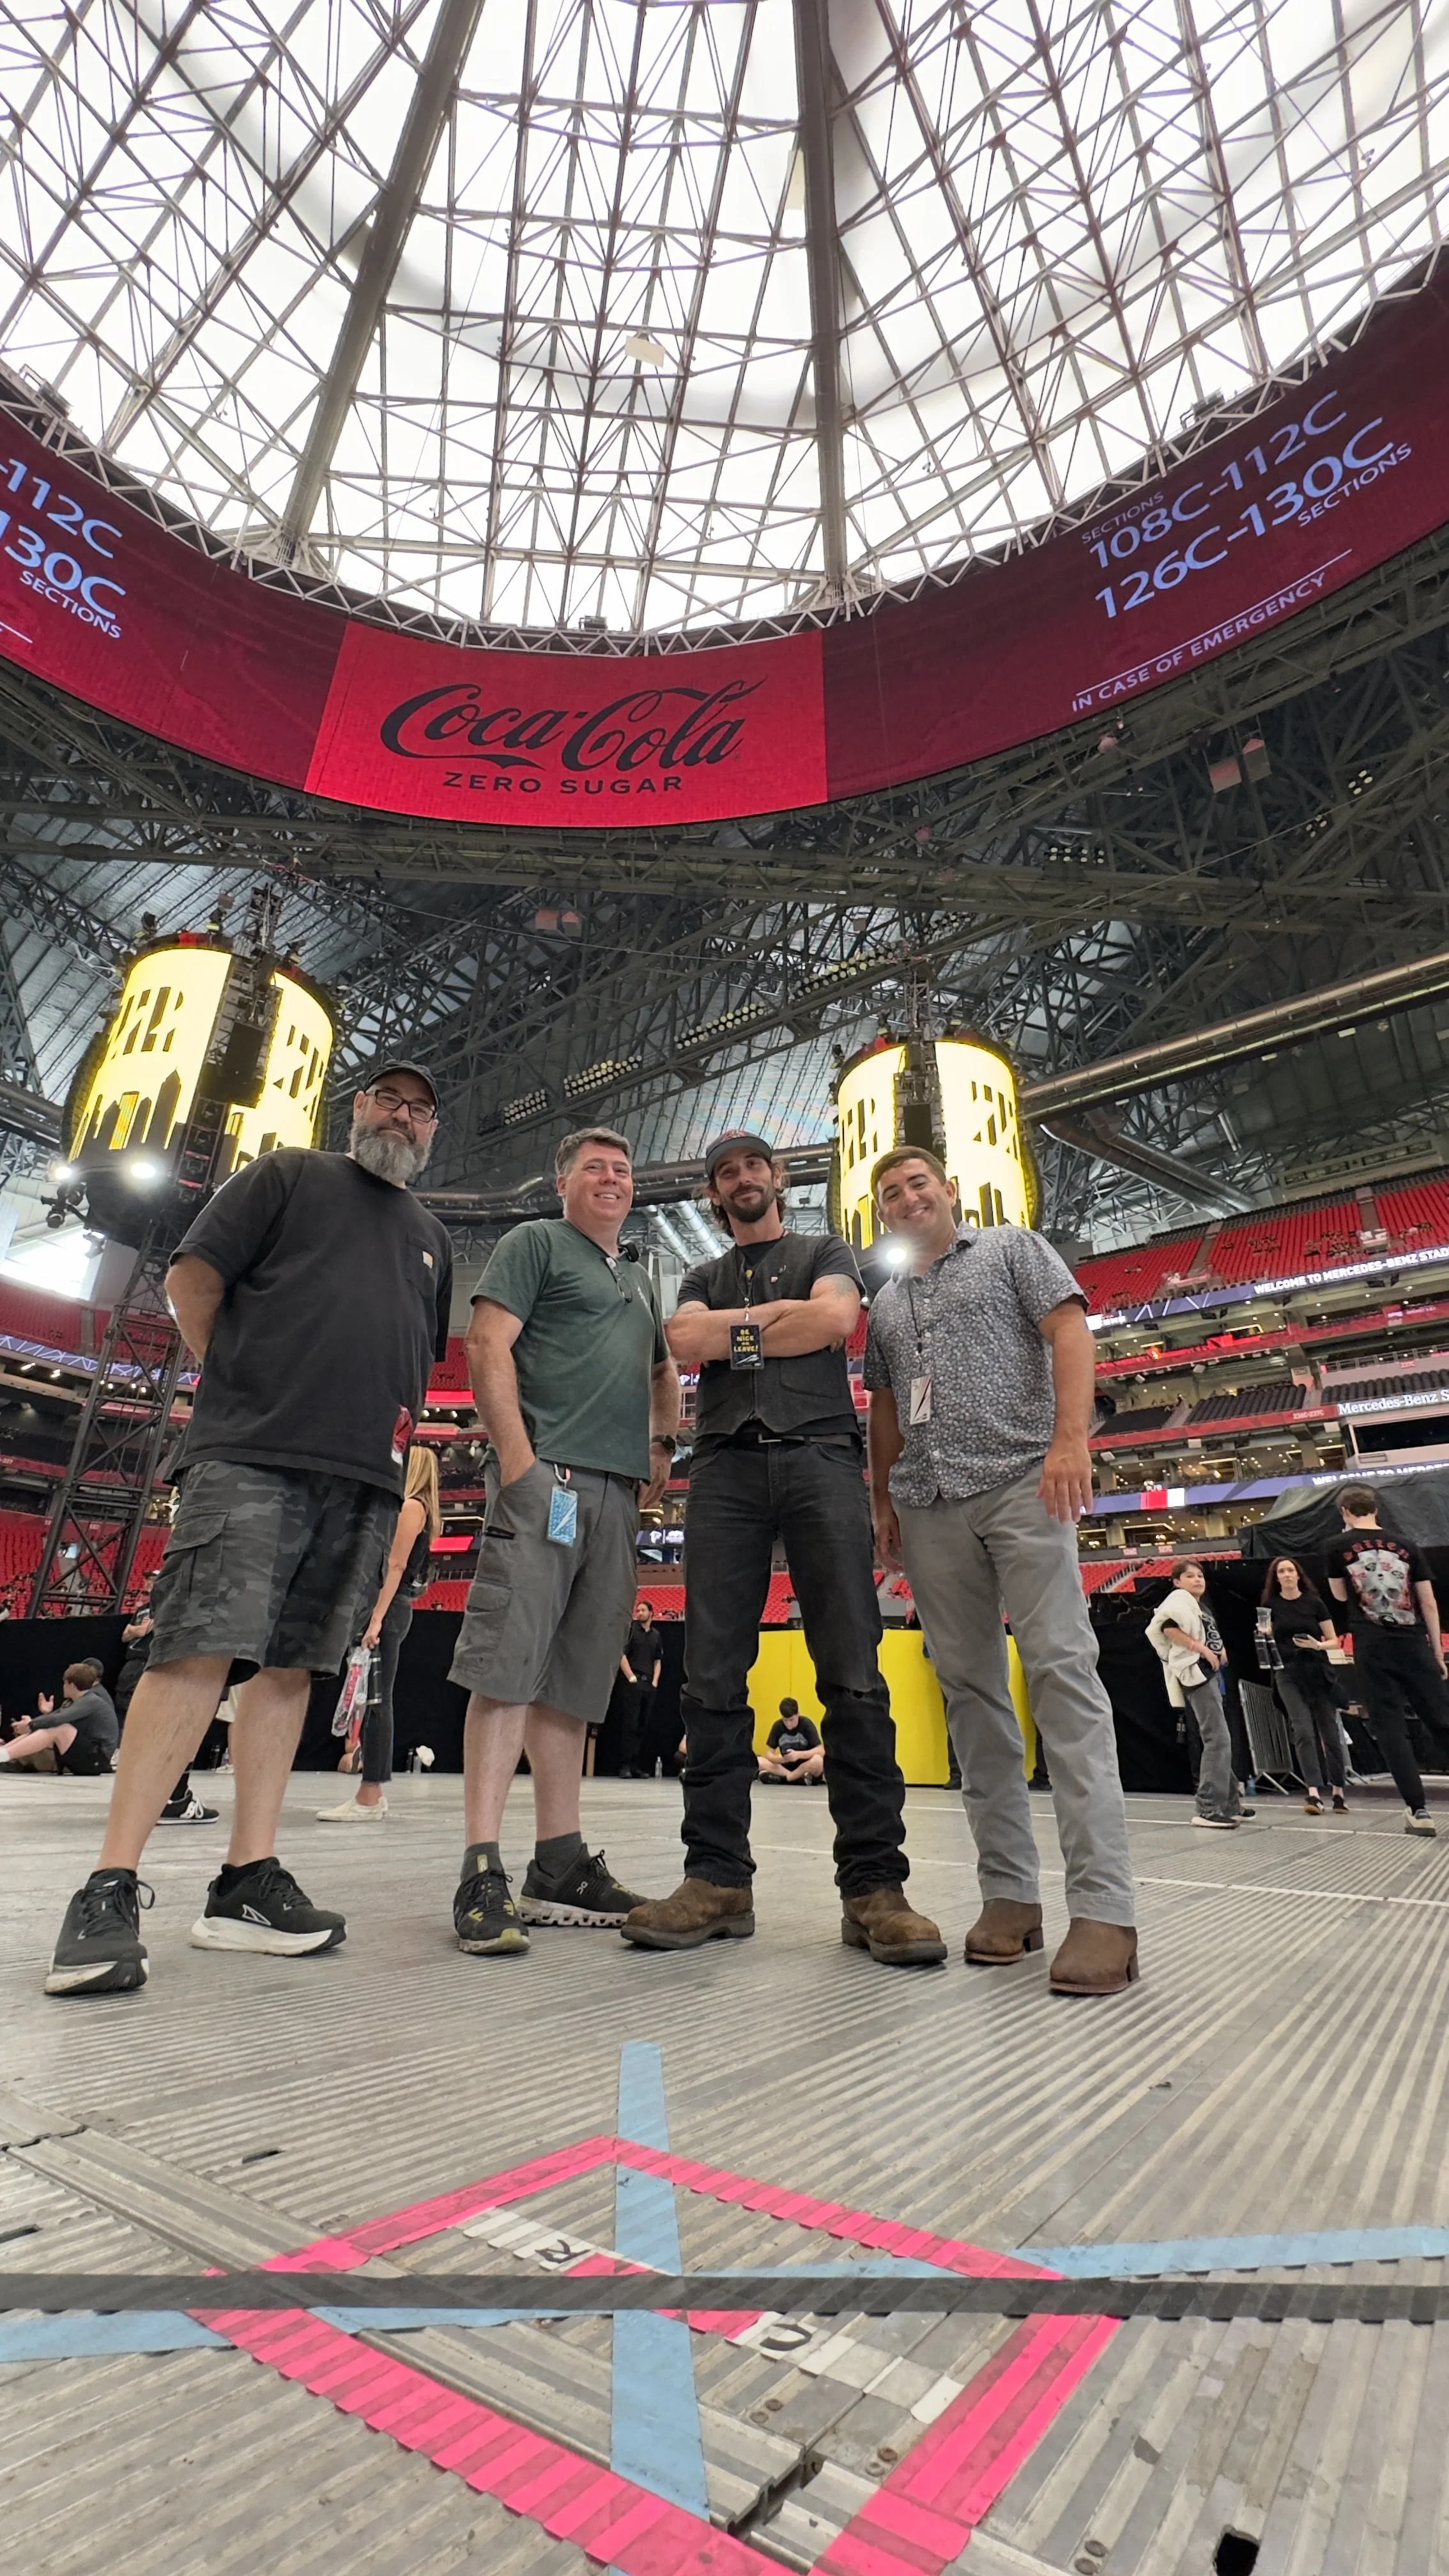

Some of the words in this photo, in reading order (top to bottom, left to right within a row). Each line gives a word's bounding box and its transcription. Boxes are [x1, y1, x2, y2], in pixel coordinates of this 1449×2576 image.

[1089, 390, 1347, 569] 108C-112C
[1298, 443, 1413, 527] SECTIONS
[1082, 491, 1164, 544] SECTIONS
[1095, 417, 1394, 618] 126C-130C
[20, 571, 121, 638] SECTIONS
[1072, 694, 1092, 712] IN
[1098, 668, 1151, 700] CASE
[1156, 651, 1183, 673] OF
[1190, 572, 1326, 657] EMERGENCY
[379, 677, 767, 772] Coca-Cola
[443, 772, 542, 793] ZERO
[560, 776, 683, 795] SUGAR
[1254, 1276, 1307, 1295] WELCOME
[1307, 1273, 1322, 1286] TO
[1322, 1252, 1418, 1283] MERCEDES-BENZ
[1418, 1247, 1449, 1262] STAD
[1337, 1393, 1438, 1415] Mercedes-Benz
[1439, 1389, 1449, 1402] S
